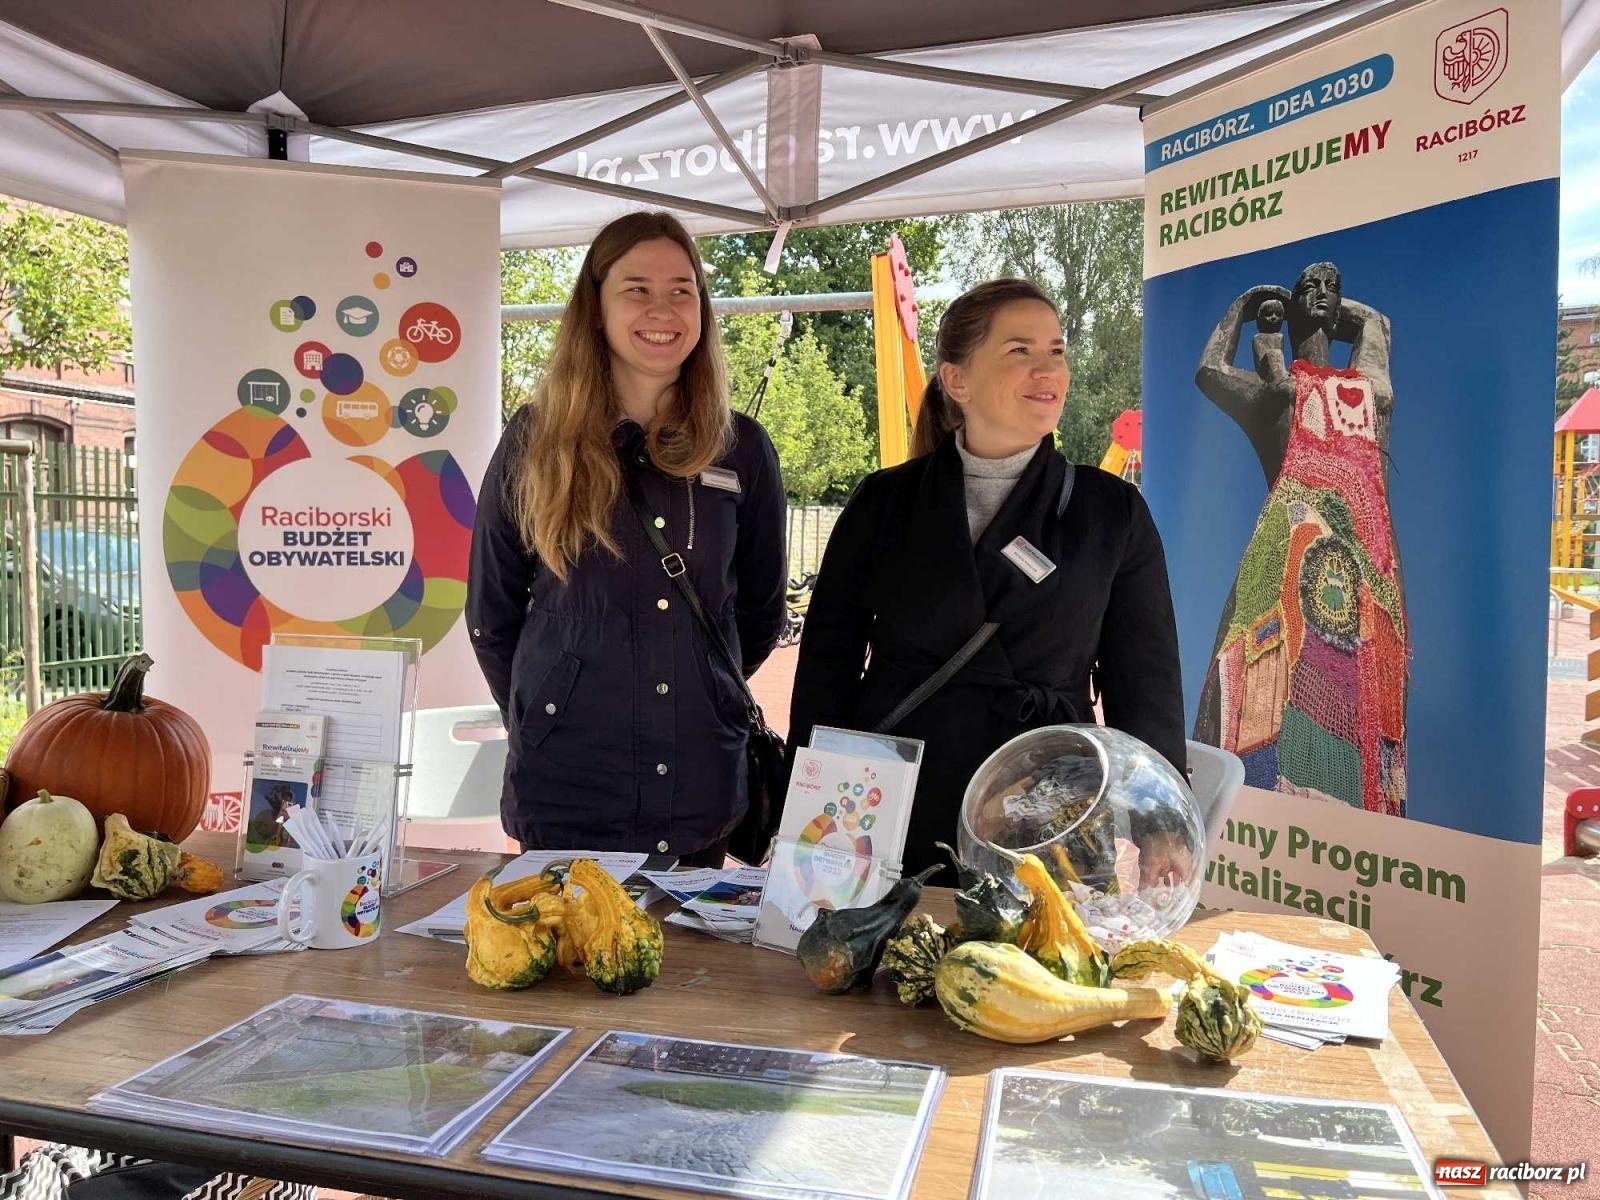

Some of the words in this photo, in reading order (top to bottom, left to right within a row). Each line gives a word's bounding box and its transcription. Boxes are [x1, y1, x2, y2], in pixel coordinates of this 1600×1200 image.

[1160, 112, 1255, 162] RACIBÓRZ.
[1268, 89, 1316, 123] IDEA
[1320, 67, 1375, 104] 2030
[1416, 104, 1526, 152] RACIBÓRZ
[1159, 119, 1393, 216] REWITALIZUJEMY
[1458, 149, 1479, 163] 1217
[1159, 190, 1284, 248] RACIBÓRZ
[261, 505, 391, 527] Raciborski
[283, 527, 372, 547] BUDŻET
[248, 550, 405, 567] OBYWATELSKI
[1287, 825, 1467, 904] Program
